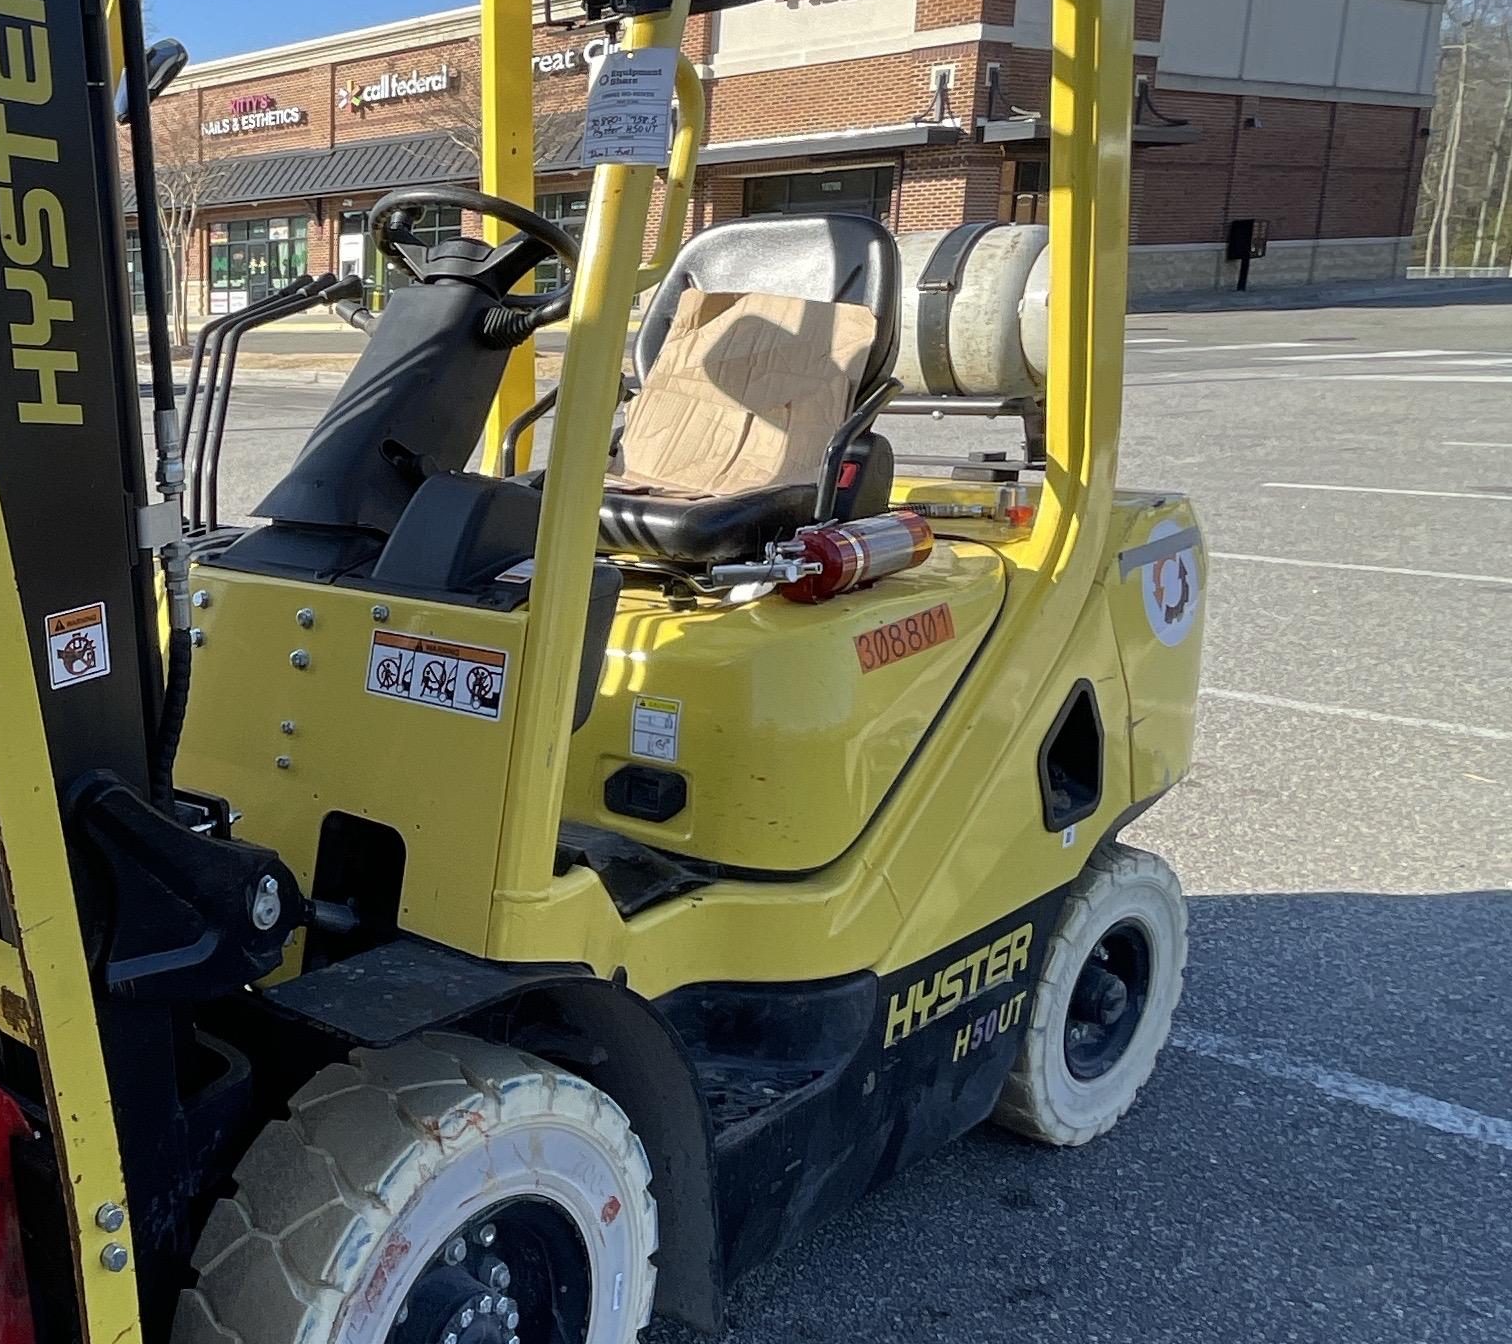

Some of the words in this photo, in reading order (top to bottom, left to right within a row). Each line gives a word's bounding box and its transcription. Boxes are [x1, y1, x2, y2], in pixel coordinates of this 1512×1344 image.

[363, 74, 389, 102] call
[390, 64, 449, 97] federal
[532, 49, 576, 73] reat
[201, 116, 230, 136] NAILS
[241, 107, 301, 131] ESTHETICS
[858, 608, 950, 670] 308801
[883, 922, 1034, 1049] HYSTER
[952, 989, 1028, 1063] H50UT
